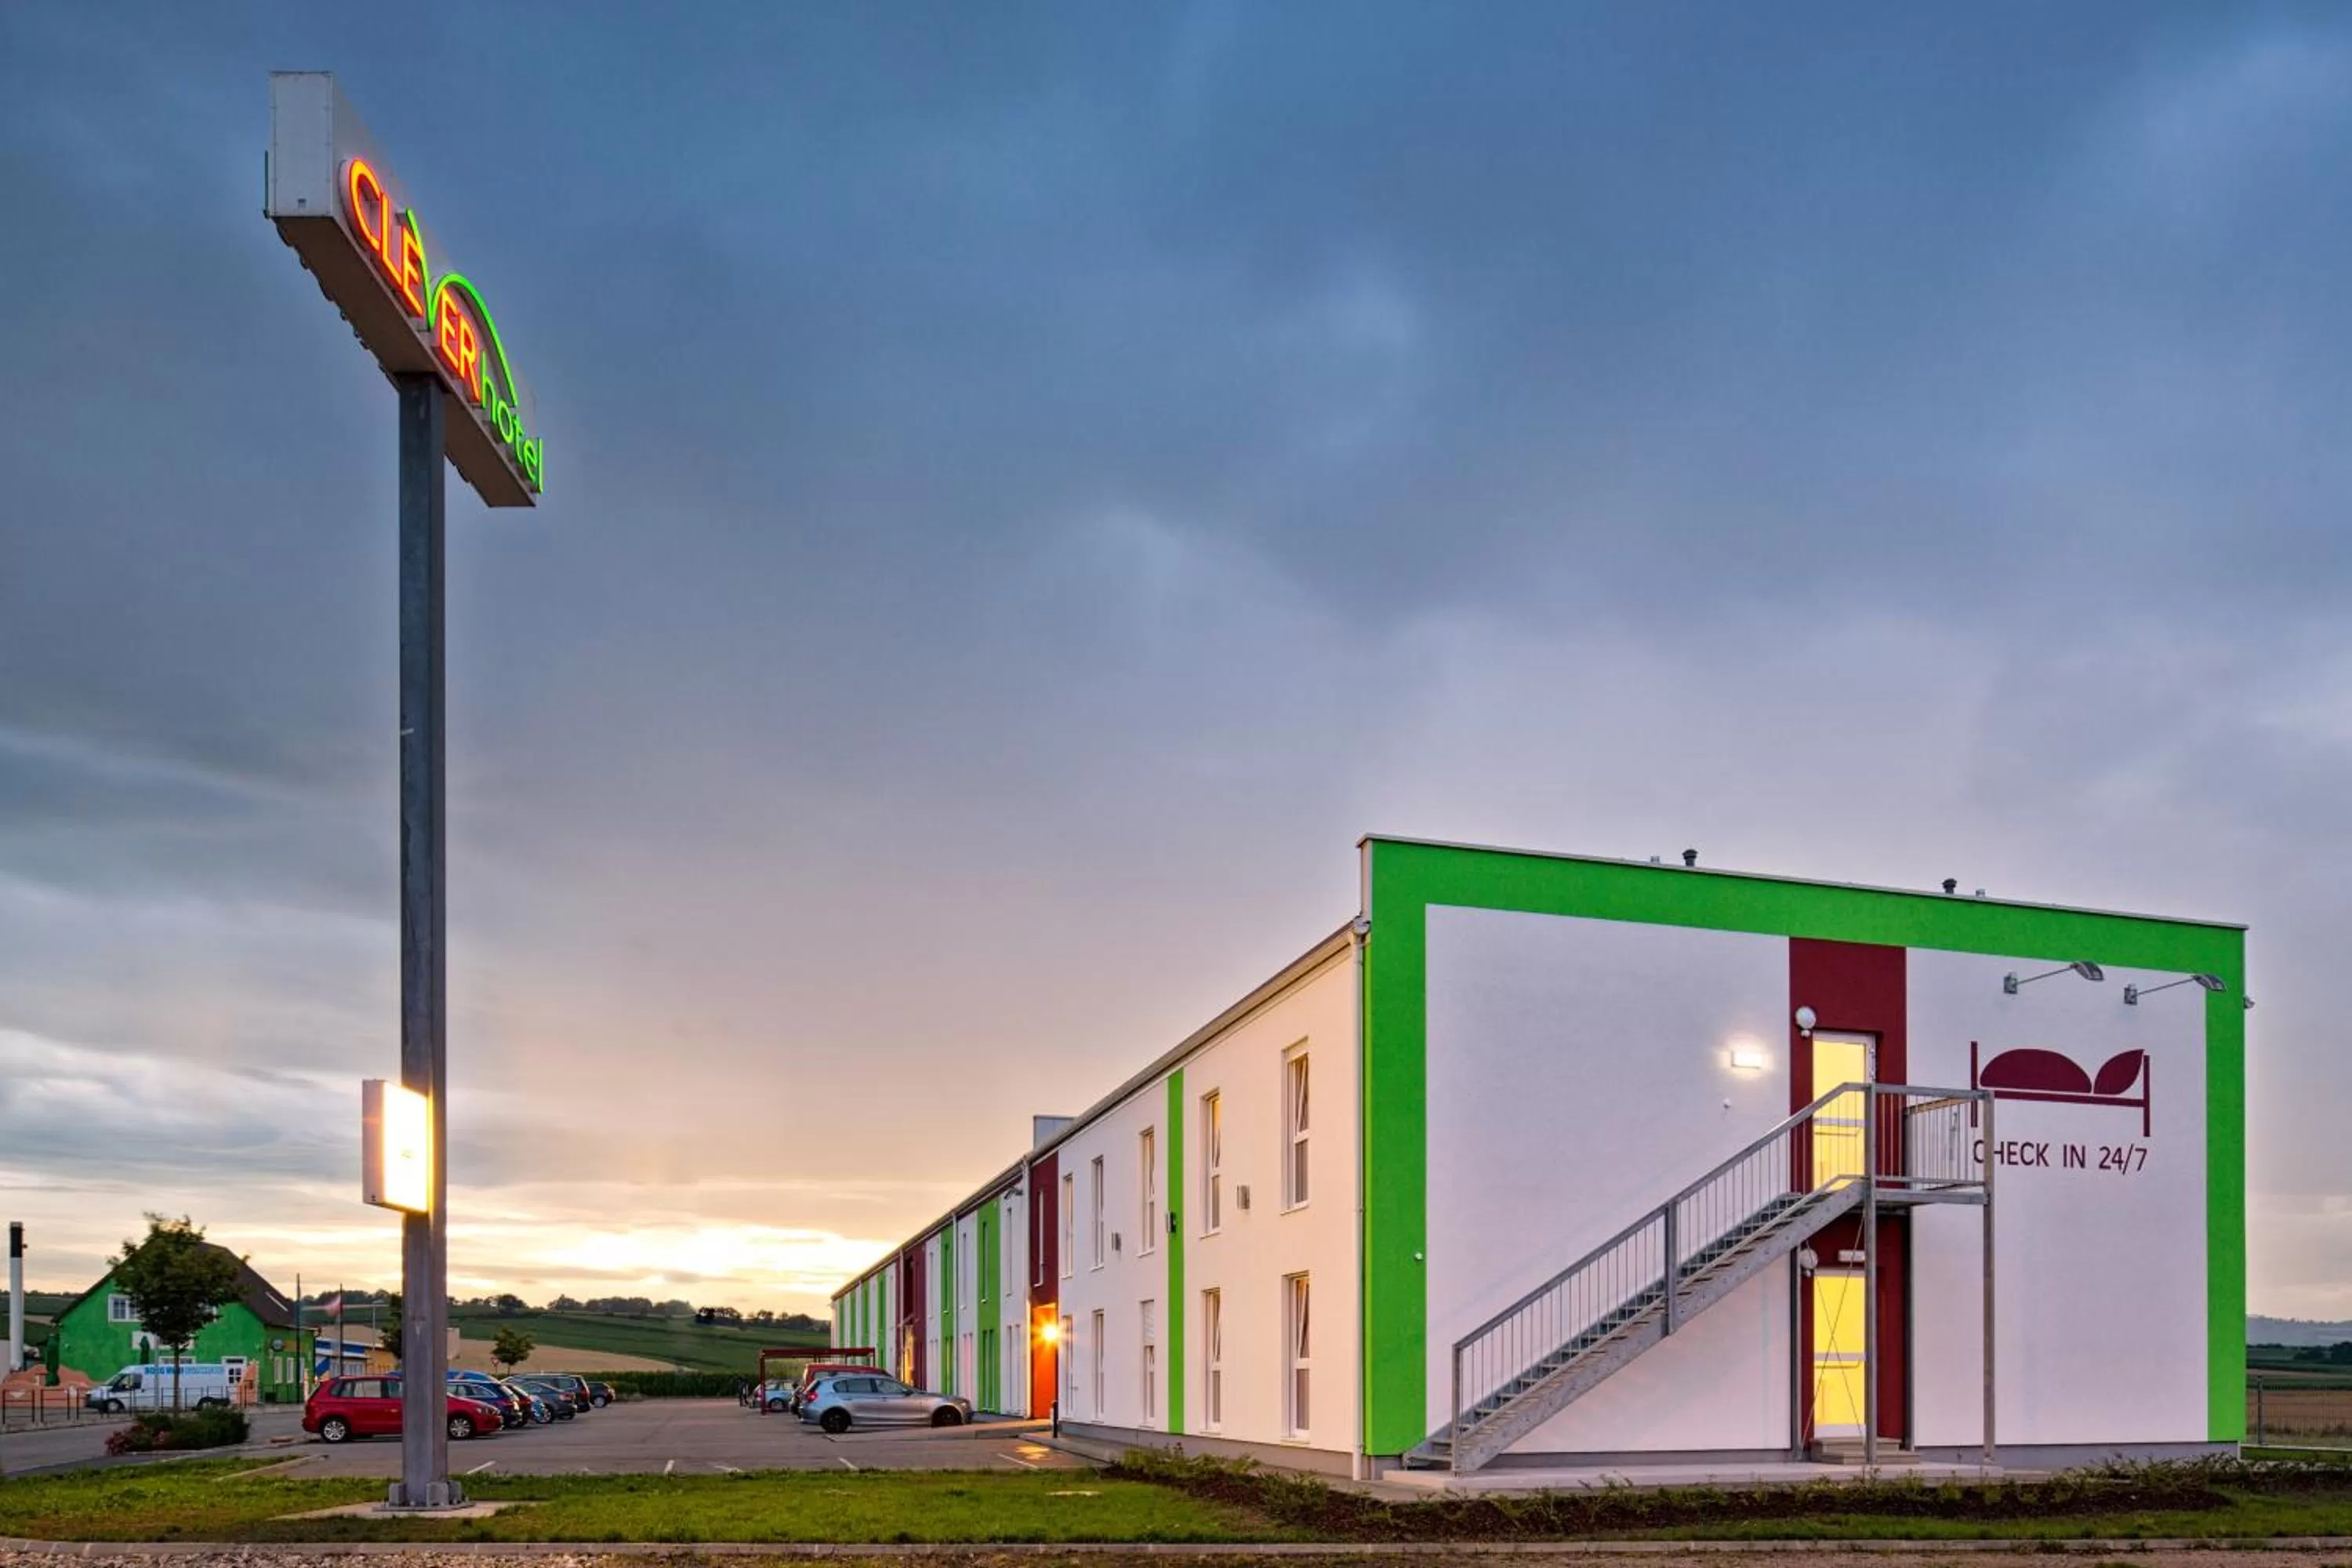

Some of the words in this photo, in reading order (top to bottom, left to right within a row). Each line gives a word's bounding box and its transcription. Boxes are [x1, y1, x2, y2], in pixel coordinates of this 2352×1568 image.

[347, 158, 518, 406] CLEVER
[481, 350, 543, 494] hotel
[2063, 1144, 2086, 1169] IN
[2099, 1143, 2148, 1175] 24/7
